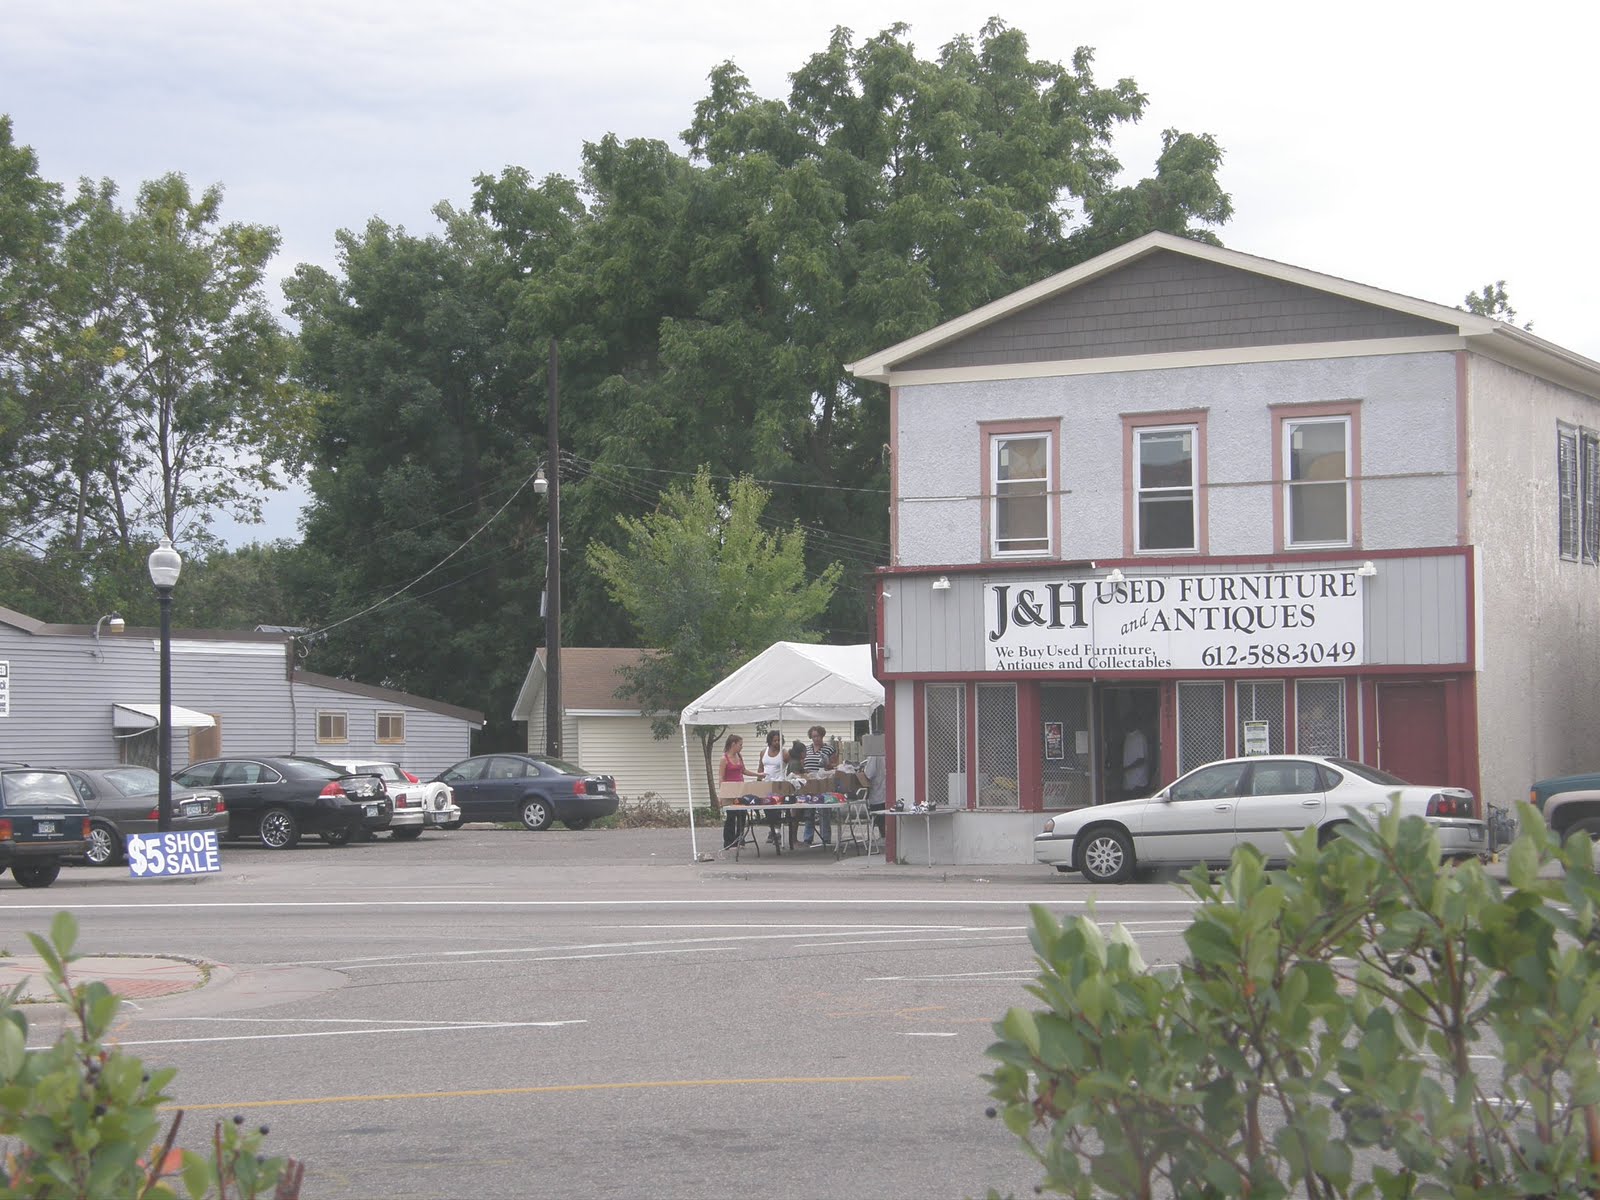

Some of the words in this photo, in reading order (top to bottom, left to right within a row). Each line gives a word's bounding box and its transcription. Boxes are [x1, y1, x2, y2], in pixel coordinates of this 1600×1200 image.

[1094, 579, 1165, 604] USED
[1179, 572, 1357, 602] FURNITURE
[988, 581, 1089, 642] J&H
[1120, 608, 1149, 636] and
[1150, 603, 1316, 634] ANTIQUES
[995, 646, 1014, 658] We
[1019, 645, 1045, 660] Buy
[1047, 643, 1079, 657] Used
[1084, 643, 1156, 657] Furniture,
[995, 659, 1054, 671] Antiques
[1058, 657, 1083, 670] and
[1088, 655, 1172, 670] Collectables
[1201, 641, 1356, 667] 612-588-3049
[128, 833, 166, 876] $5
[164, 831, 218, 854] SHOE
[166, 851, 220, 874] SALE
